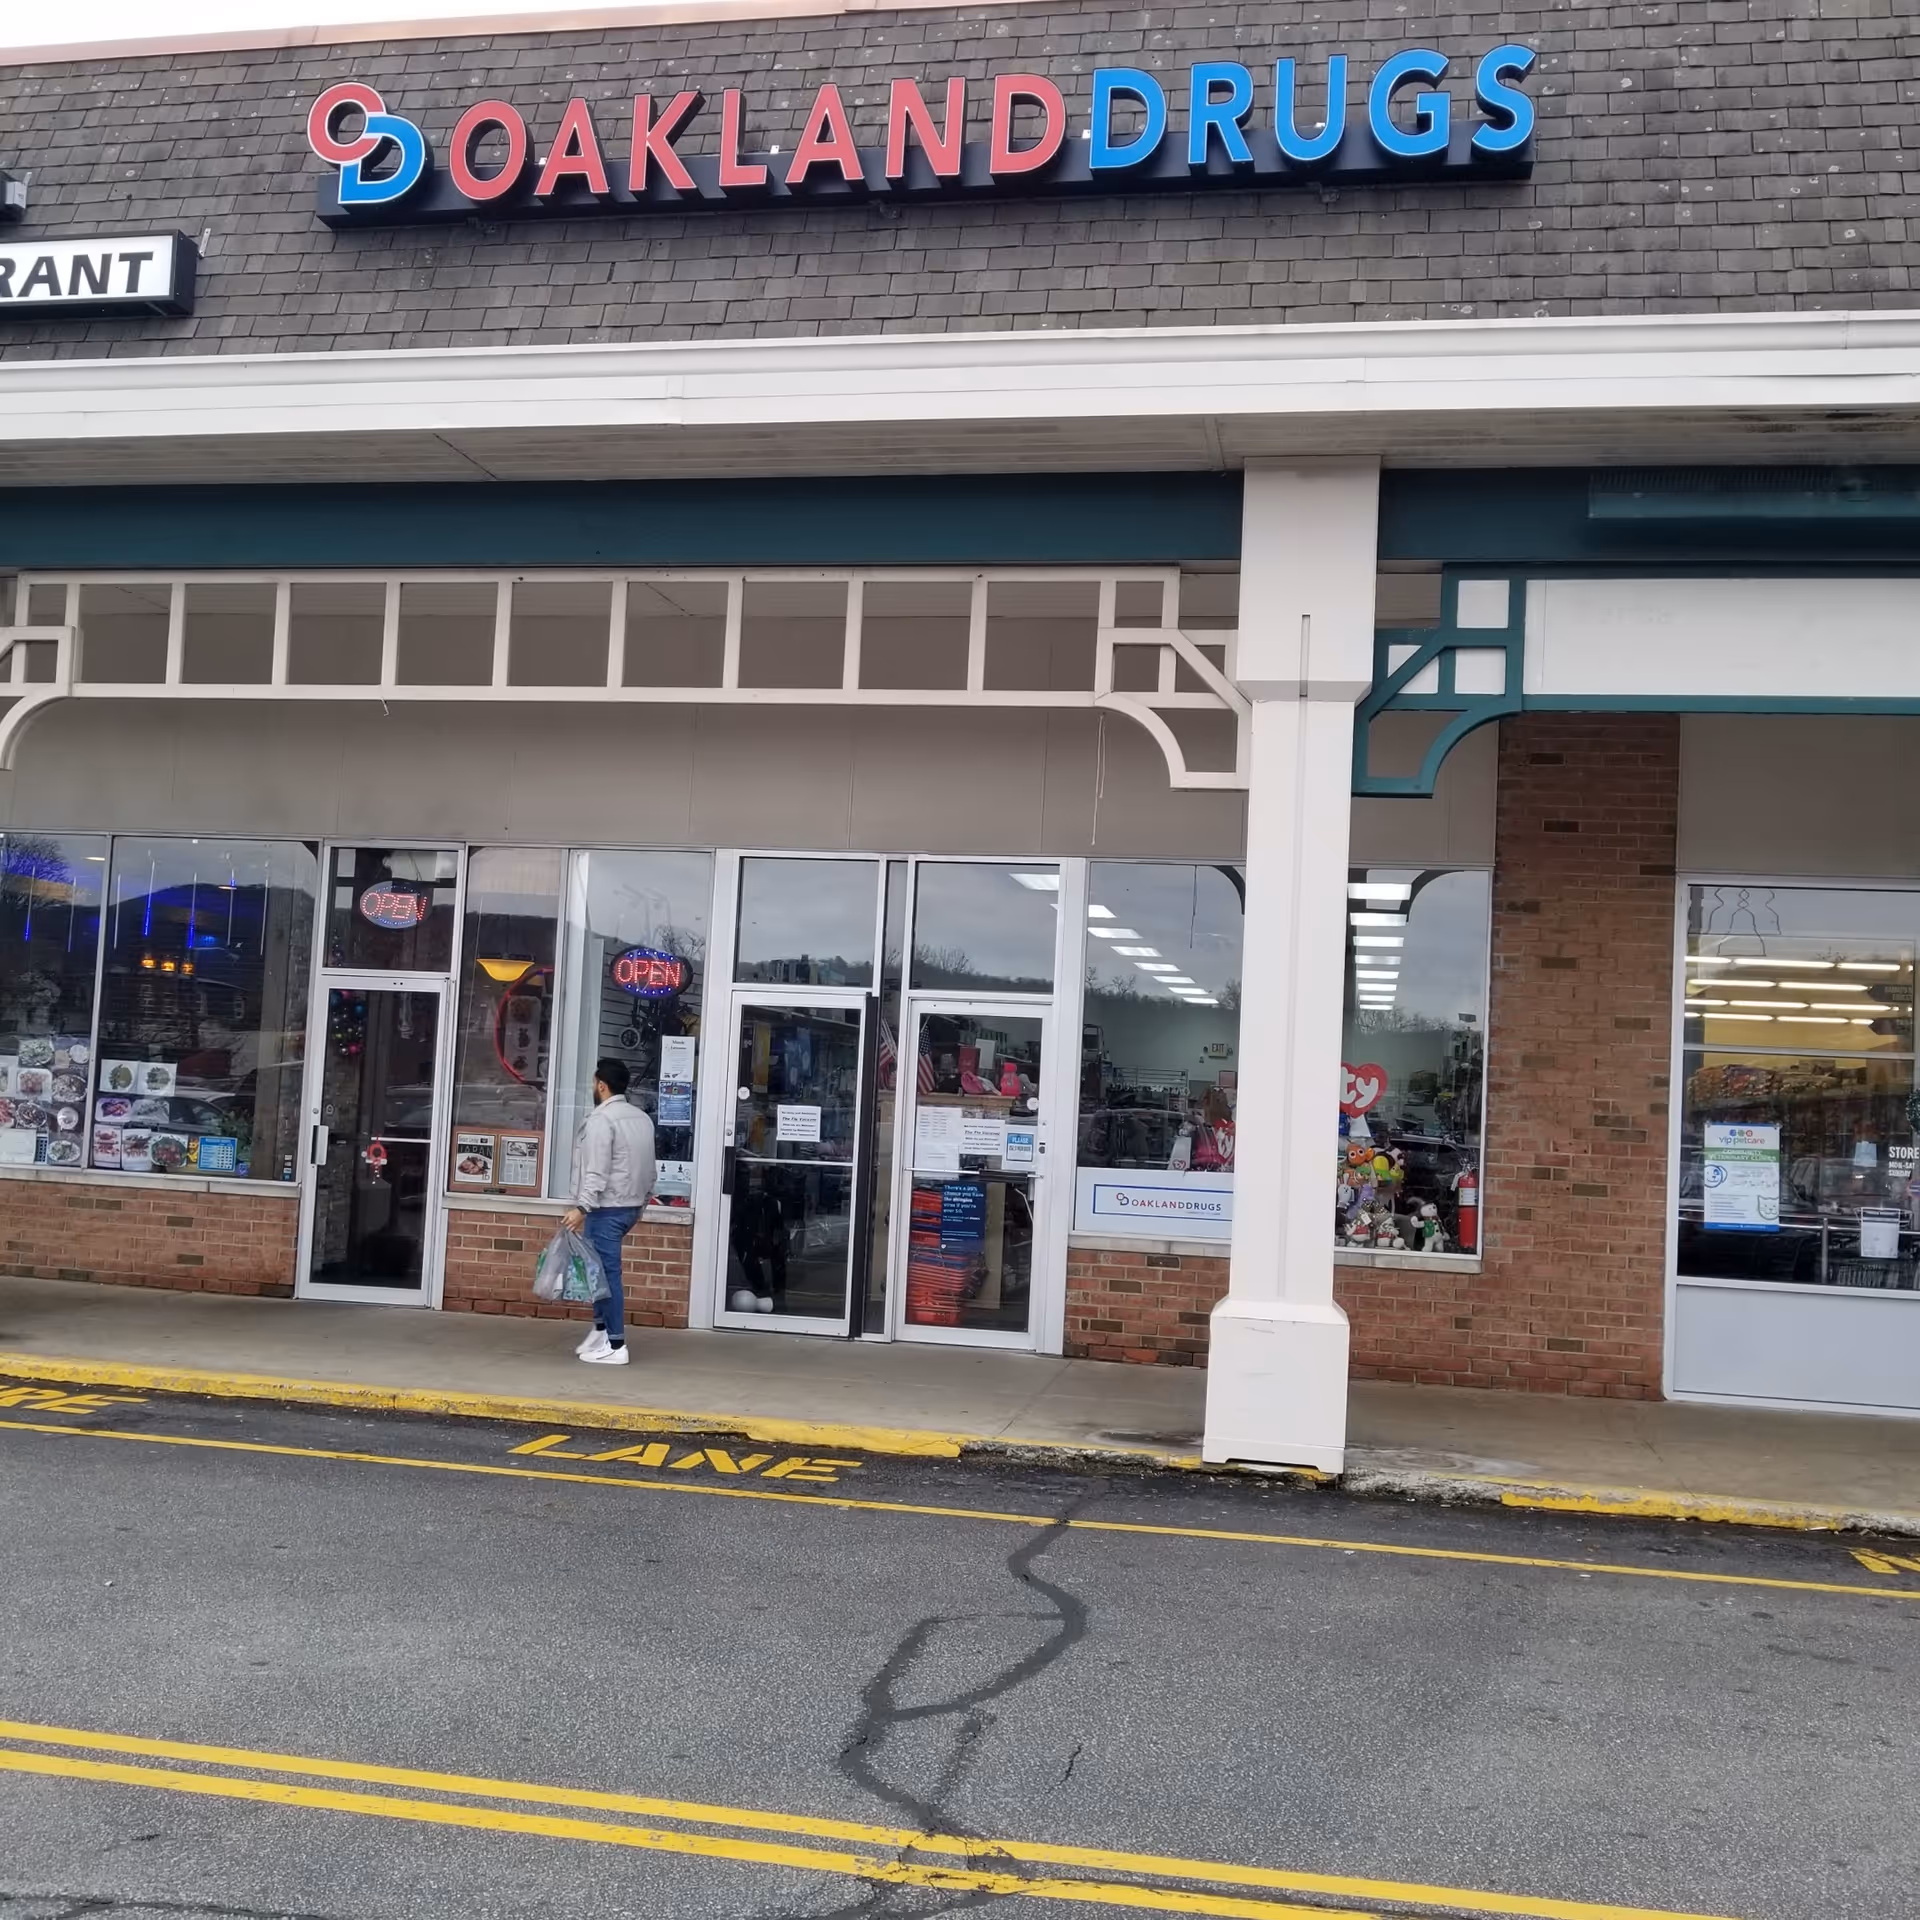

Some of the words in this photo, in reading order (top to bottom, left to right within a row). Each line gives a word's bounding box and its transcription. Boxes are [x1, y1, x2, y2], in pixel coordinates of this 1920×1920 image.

[363, 892, 428, 920] OPEN
[617, 959, 680, 986] OPEN
[1211, 1043, 1225, 1053] EXIT
[1341, 1066, 1379, 1108] ty
[1719, 1136, 1732, 1144] vip
[1733, 1137, 1765, 1145] petcare
[1889, 1146, 1920, 1159] STORE
[0, 1385, 150, 1414] RE
[508, 1434, 863, 1482] LANE
